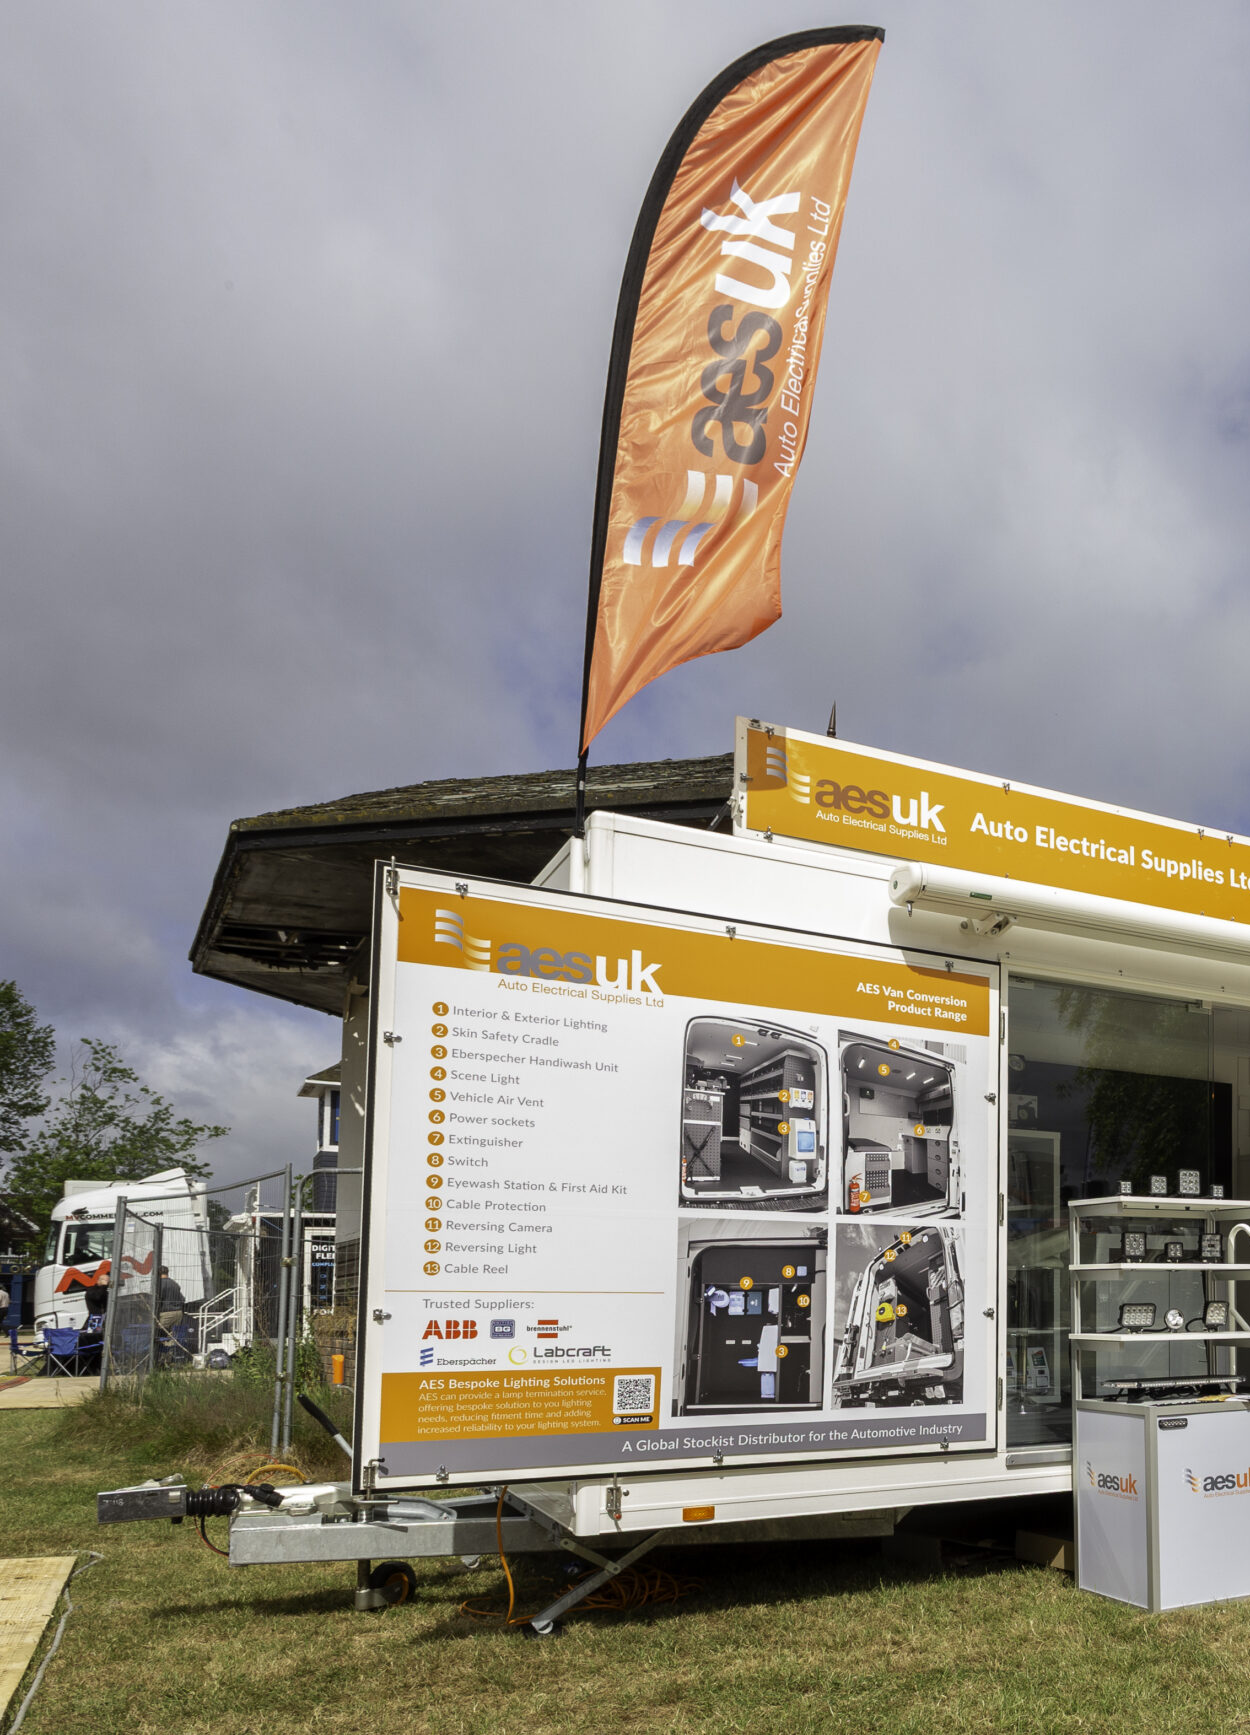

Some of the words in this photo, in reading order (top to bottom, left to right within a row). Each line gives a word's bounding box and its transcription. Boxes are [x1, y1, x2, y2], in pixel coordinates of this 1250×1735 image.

[691, 177, 801, 465] aesuk
[773, 421, 799, 478] Auto
[807, 196, 831, 236] Ltd
[815, 778, 945, 832] aesuk
[816, 810, 839, 823] Auto
[842, 814, 886, 832] Electrical
[889, 825, 929, 843] Supplies
[932, 834, 947, 845] Ltd
[970, 812, 1028, 843] Auto
[1035, 826, 1135, 866] Electrical
[1141, 850, 1225, 886] Supplies
[497, 942, 664, 994] aesuk
[498, 978, 528, 992] Auto
[532, 982, 587, 999] Electrical
[591, 990, 642, 1006] Supplies
[646, 996, 664, 1008] Ltd
[857, 982, 880, 994] AES
[883, 986, 904, 998] Van
[907, 989, 967, 1007] Conversion
[453, 1005, 498, 1019] Interior
[501, 1010, 510, 1021] &
[514, 1012, 560, 1026] Exterior
[563, 1018, 608, 1033] Lighting
[888, 1001, 931, 1016] Product
[934, 1006, 967, 1022] Range
[452, 1026, 478, 1038] Skin
[481, 1030, 518, 1044] Safety
[522, 1035, 559, 1046] Cradle
[452, 1049, 526, 1065] Eberspecher
[529, 1055, 592, 1070] Handiwash
[595, 1060, 618, 1072] Unit
[451, 1070, 487, 1082] Scene
[490, 1072, 520, 1086] Light
[450, 1091, 493, 1104] Vehicle
[497, 1095, 514, 1106] Air
[517, 1097, 544, 1108] Vent
[449, 1113, 487, 1125] Power
[491, 1116, 535, 1128] sockets
[449, 1135, 523, 1149] Extinguisher
[448, 1155, 489, 1167] Switch
[447, 1177, 500, 1192] Eyewash
[504, 1180, 545, 1192] Station
[548, 1182, 557, 1192] &
[561, 1182, 586, 1193] First
[589, 1183, 608, 1194] Aid
[611, 1184, 627, 1194] Kit
[446, 1199, 481, 1210] Cable
[485, 1201, 546, 1212] Protection
[446, 1220, 504, 1234] Reversing
[508, 1222, 553, 1233] Camera
[445, 1242, 504, 1255] Reversing
[508, 1243, 537, 1255] Light
[444, 1263, 480, 1274] Cable
[483, 1264, 508, 1274] Reel
[423, 1299, 470, 1309] Trusted
[474, 1298, 534, 1313] Suppliers:
[422, 1320, 478, 1340] ABB
[436, 1356, 496, 1367] Eberspächer
[533, 1346, 611, 1358] Labcraft
[420, 1379, 445, 1390] AES
[449, 1378, 500, 1390] Bespoke
[504, 1376, 550, 1389] Lighting
[554, 1376, 606, 1386] Solutions
[622, 1441, 632, 1452] A
[636, 1438, 679, 1451] Global
[683, 1434, 734, 1449] Stockist
[738, 1430, 804, 1446] Distributor
[808, 1430, 826, 1442] for
[829, 1429, 848, 1440] the
[851, 1426, 916, 1439] Automotive
[919, 1424, 963, 1437] Industry
[1098, 1472, 1138, 1495] aesuk
